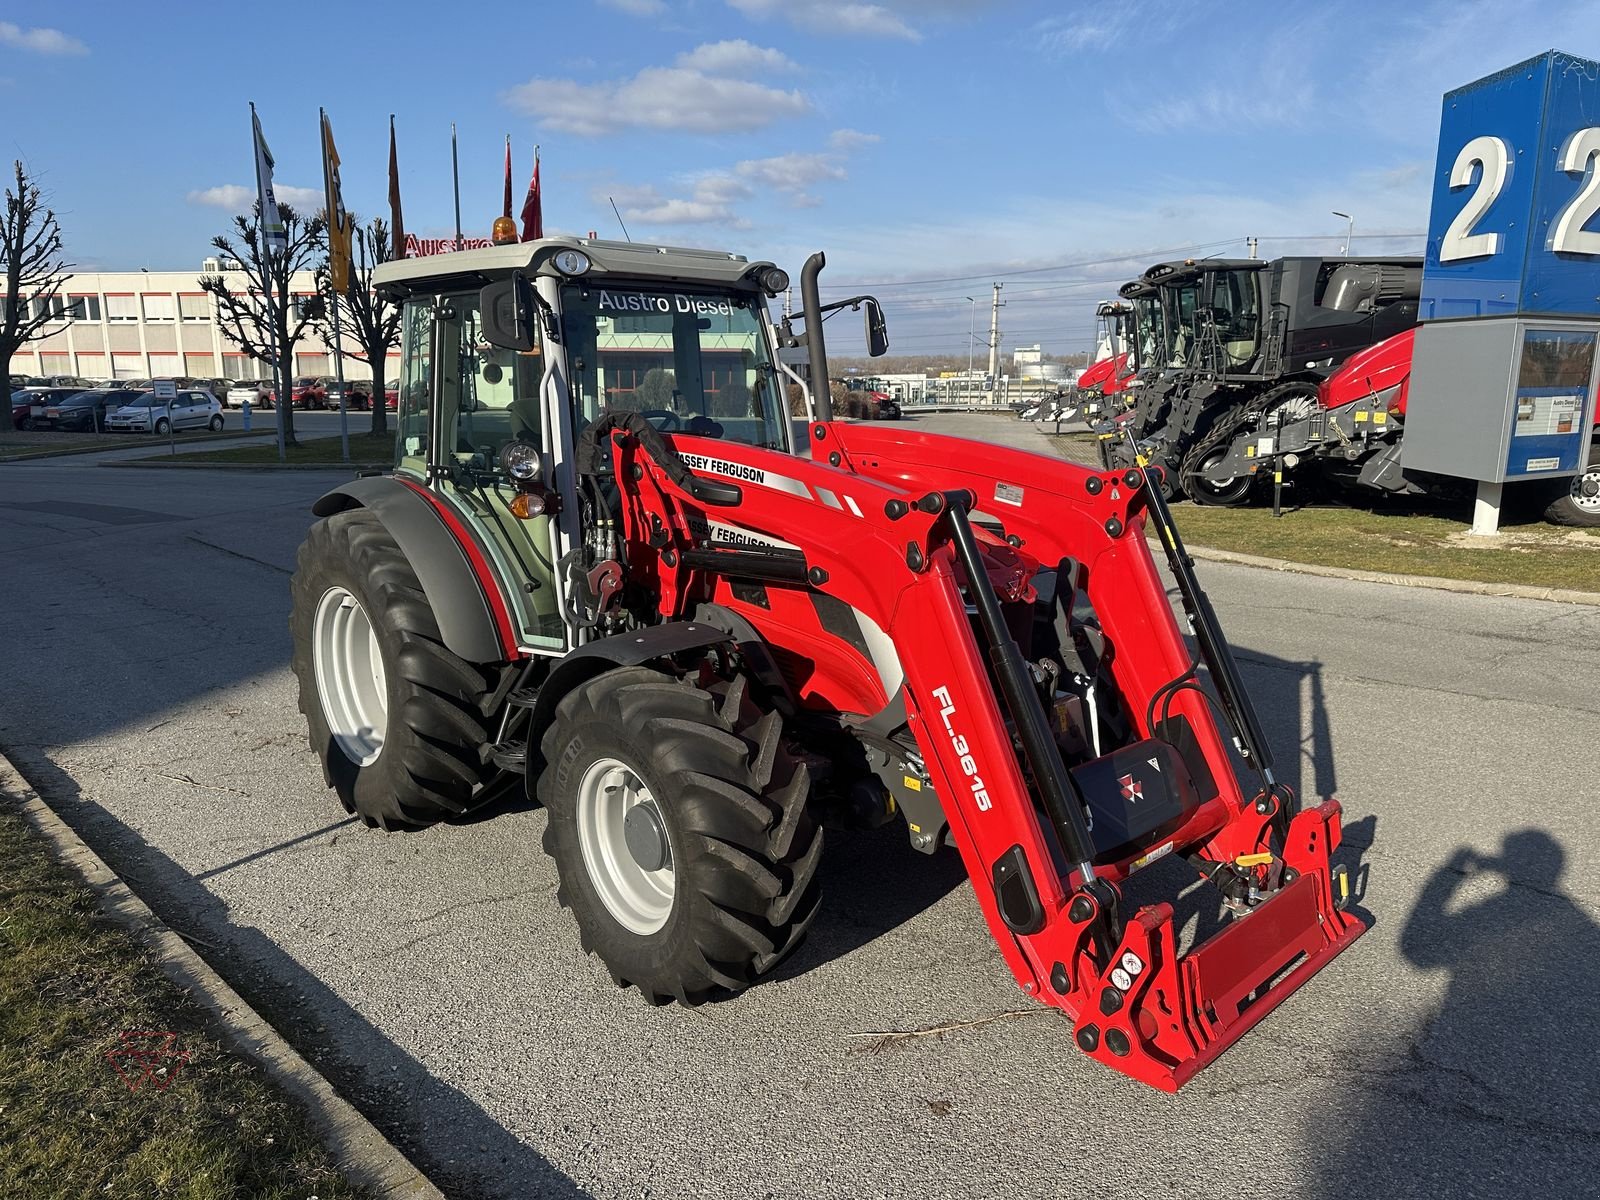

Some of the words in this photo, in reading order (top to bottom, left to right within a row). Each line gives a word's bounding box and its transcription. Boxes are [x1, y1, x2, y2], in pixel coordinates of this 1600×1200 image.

[1440, 136, 1507, 261] 2
[599, 289, 670, 313] Austro
[675, 294, 734, 316] Diesel
[711, 460, 764, 483] FERGUSON
[932, 685, 993, 812] FL.3615
